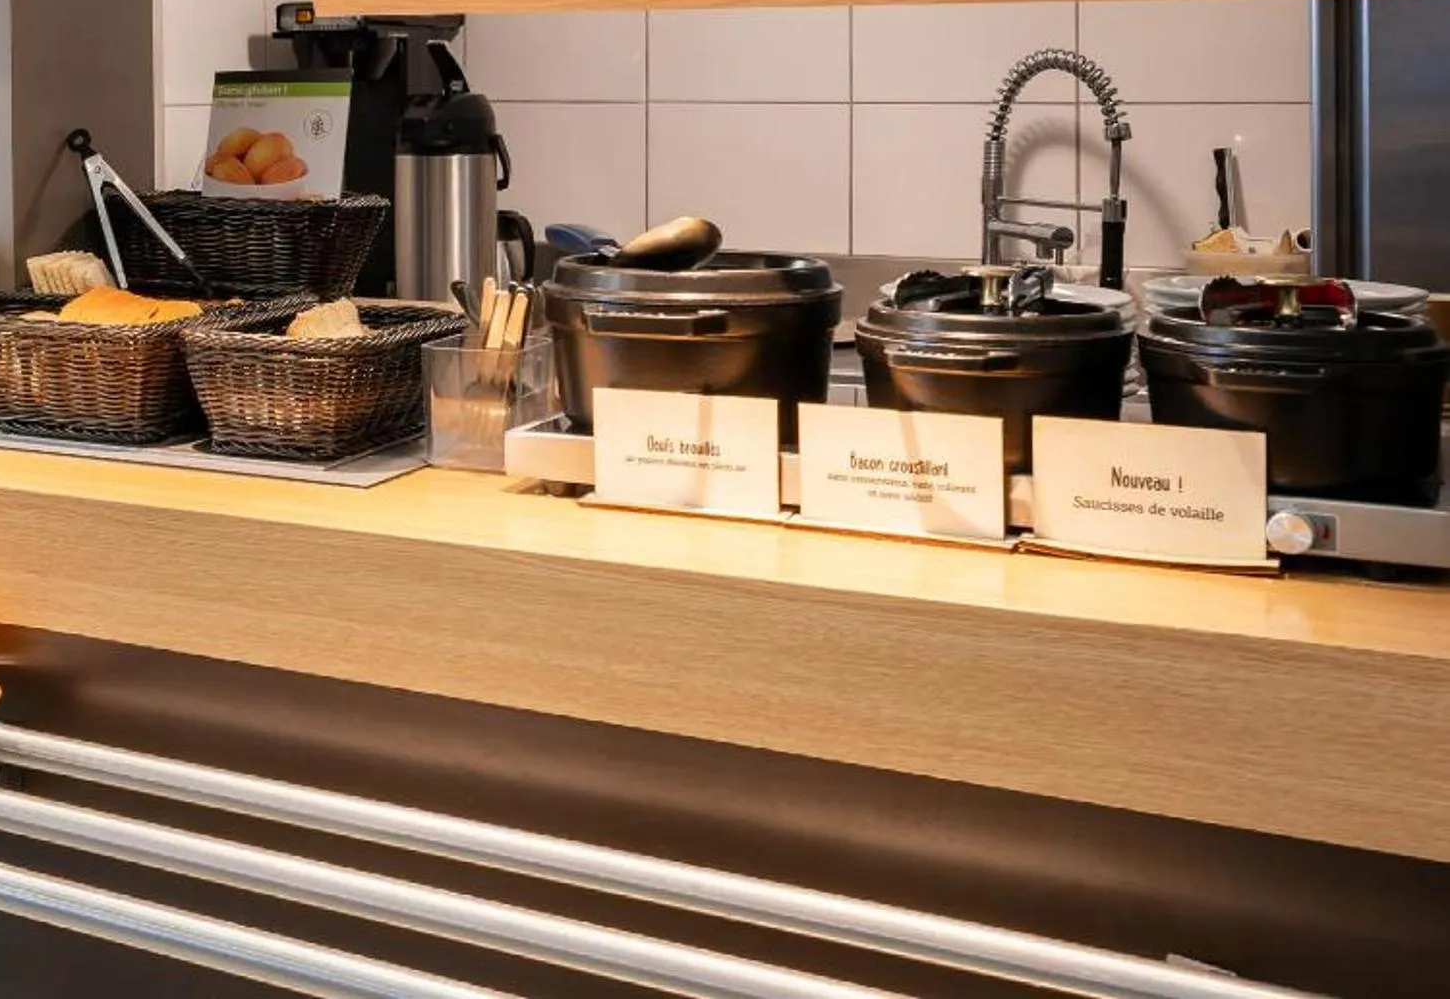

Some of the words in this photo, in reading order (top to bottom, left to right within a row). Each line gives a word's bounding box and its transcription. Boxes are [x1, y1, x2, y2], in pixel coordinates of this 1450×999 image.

[1110, 465, 1171, 492] Nouveau
[1178, 475, 1184, 493] !
[1073, 496, 1145, 515] Saucisses
[1148, 503, 1167, 517] de
[1171, 506, 1225, 522] volaille
